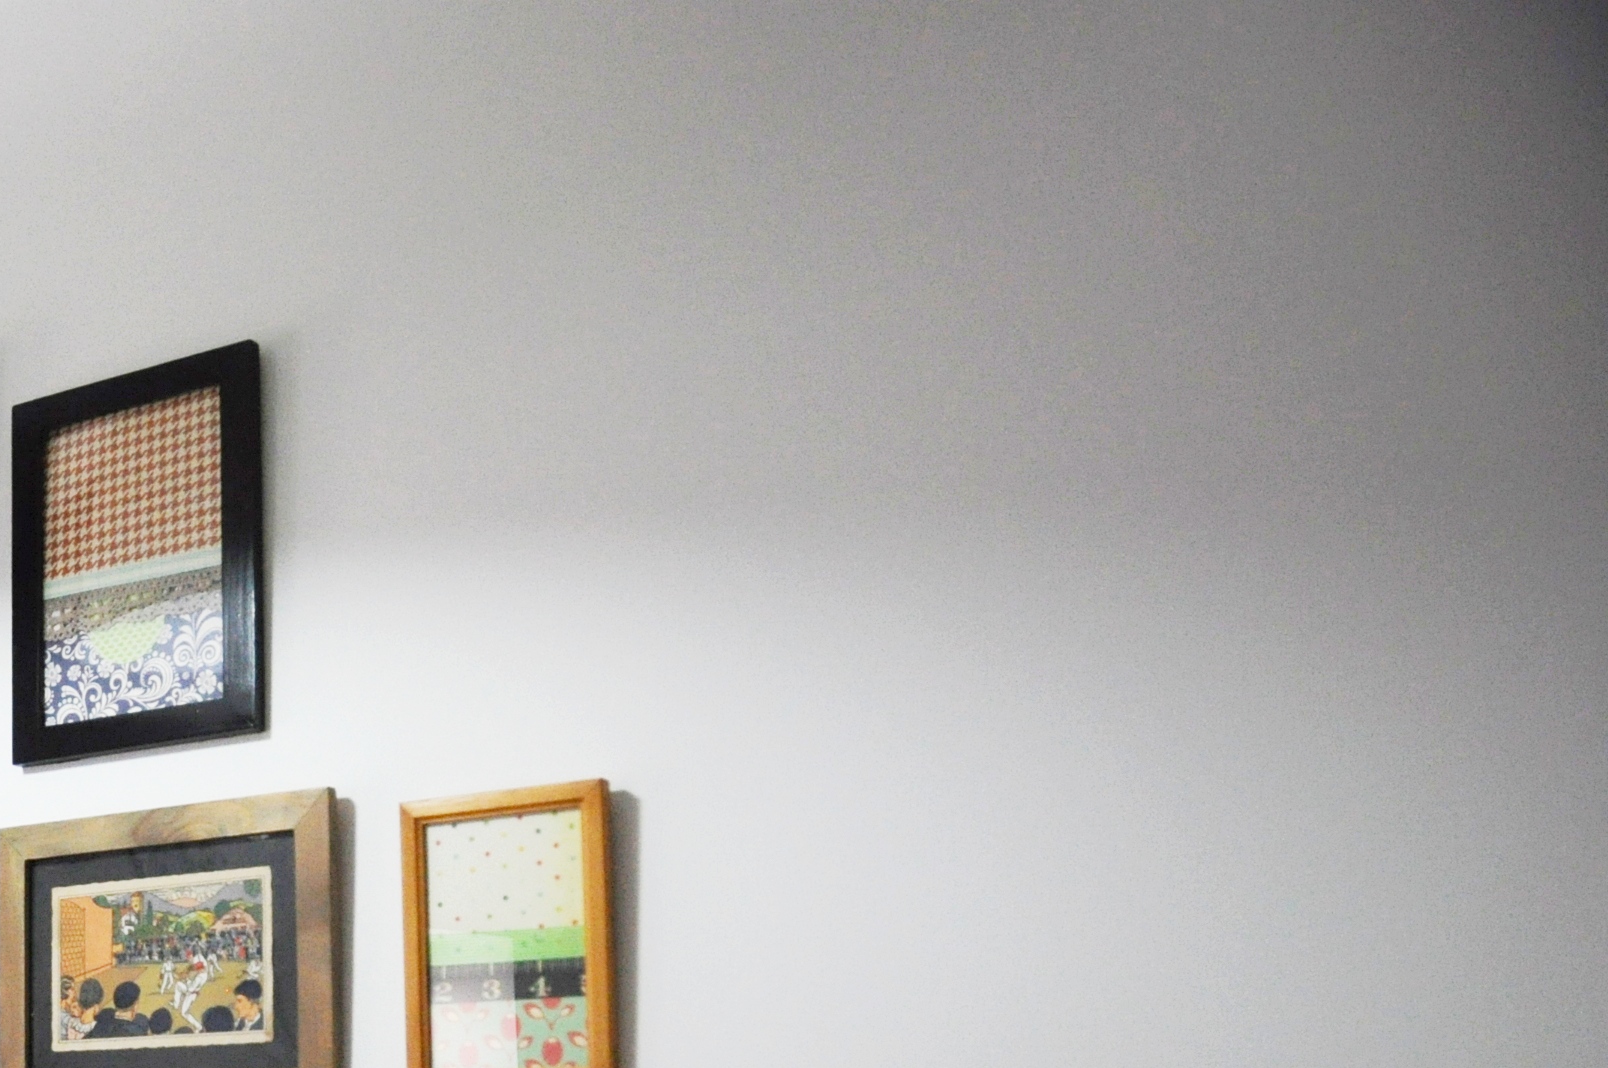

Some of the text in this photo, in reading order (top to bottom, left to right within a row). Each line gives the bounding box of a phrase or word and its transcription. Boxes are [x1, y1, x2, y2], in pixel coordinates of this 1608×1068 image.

[433, 975, 552, 1001] 2 3 4
